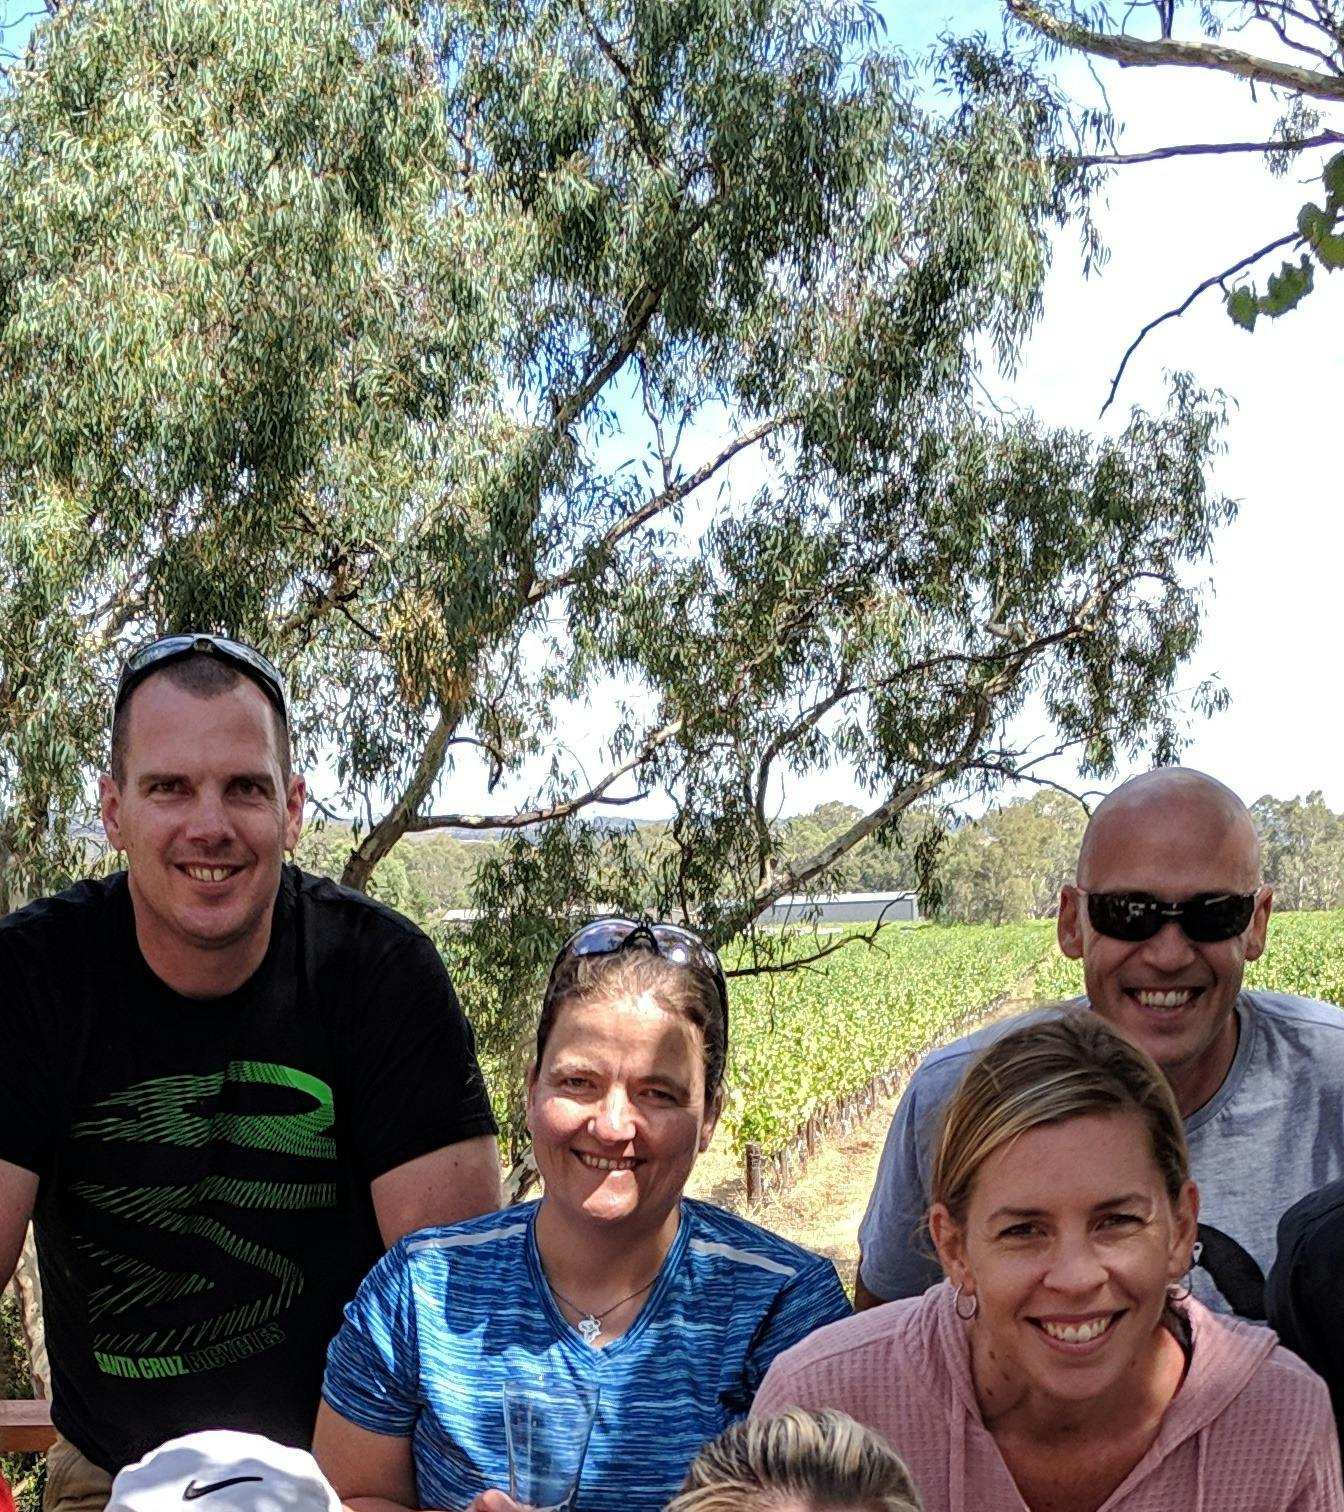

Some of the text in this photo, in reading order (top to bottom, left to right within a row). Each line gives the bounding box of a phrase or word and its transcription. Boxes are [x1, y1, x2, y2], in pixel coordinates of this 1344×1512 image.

[94, 1321, 287, 1379] SANTA CRUZ BICYCLES
